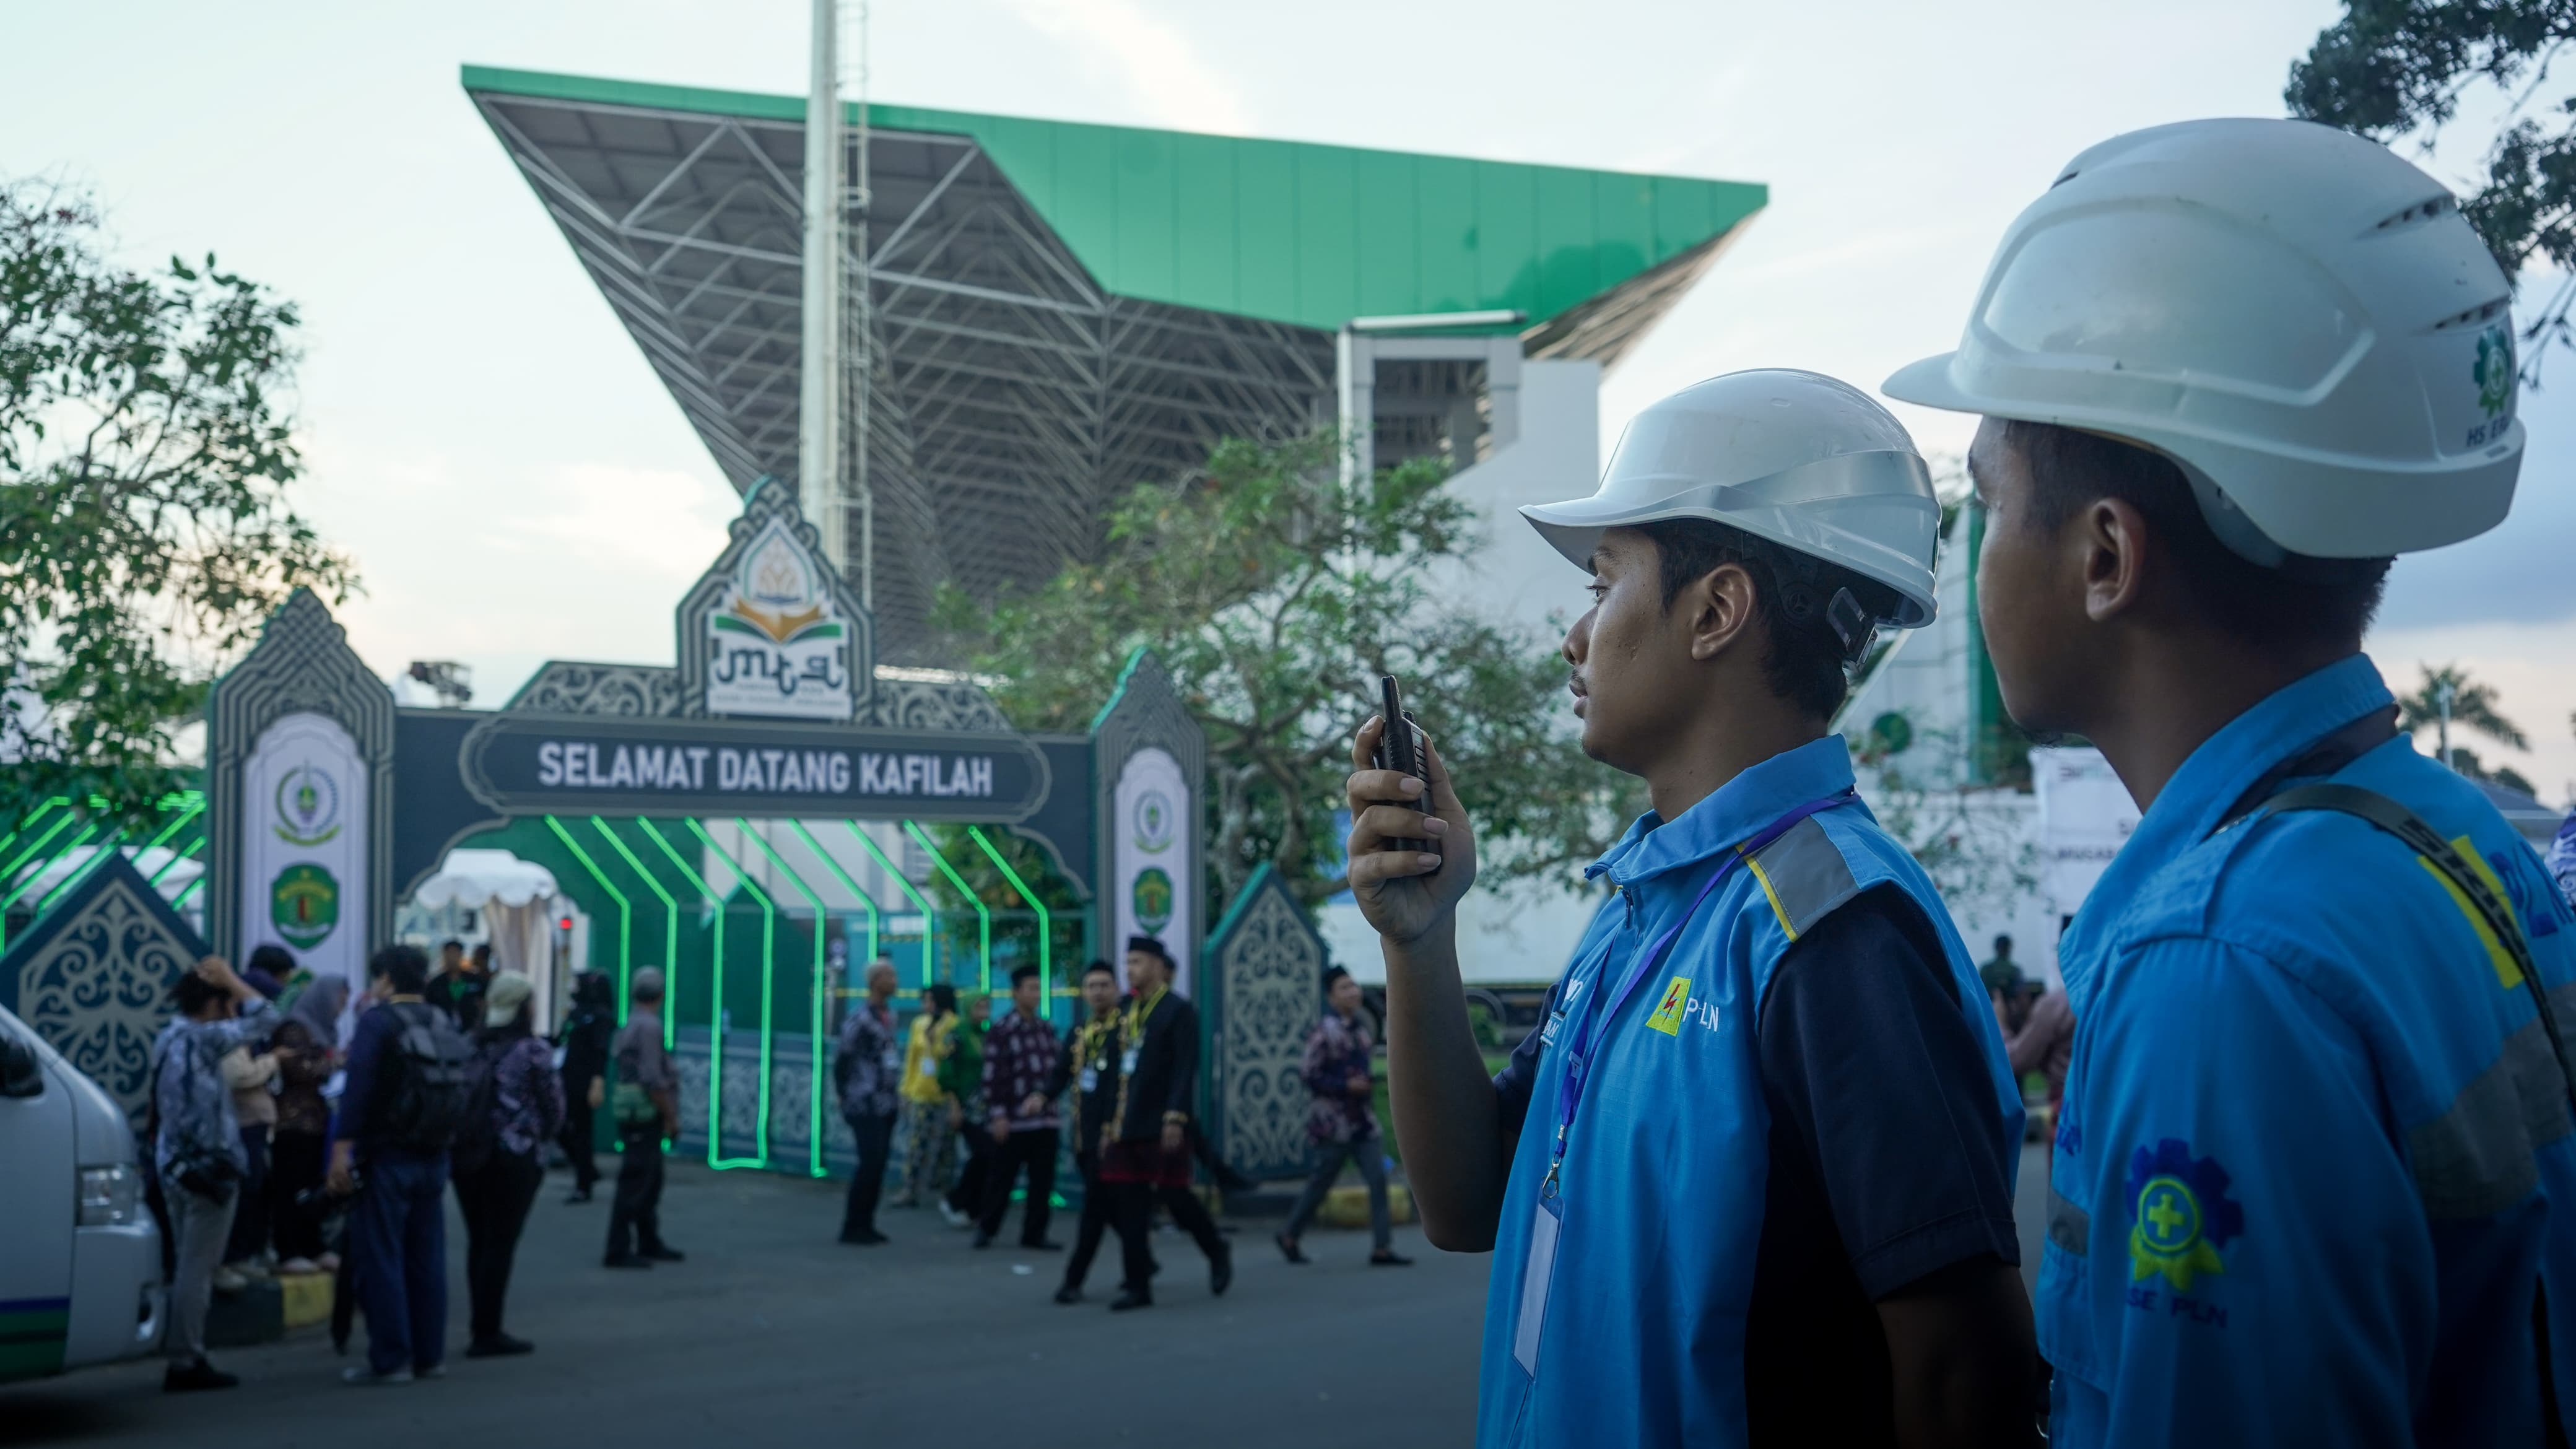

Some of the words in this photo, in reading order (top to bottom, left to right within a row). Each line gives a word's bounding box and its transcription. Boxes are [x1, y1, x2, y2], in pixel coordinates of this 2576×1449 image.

[538, 742, 710, 790] SELAMAT
[718, 749, 851, 793] DATANG
[859, 753, 993, 796] KAFILAH
[1682, 997, 1719, 1032] PLN
[2170, 1297, 2227, 1328] PLN
